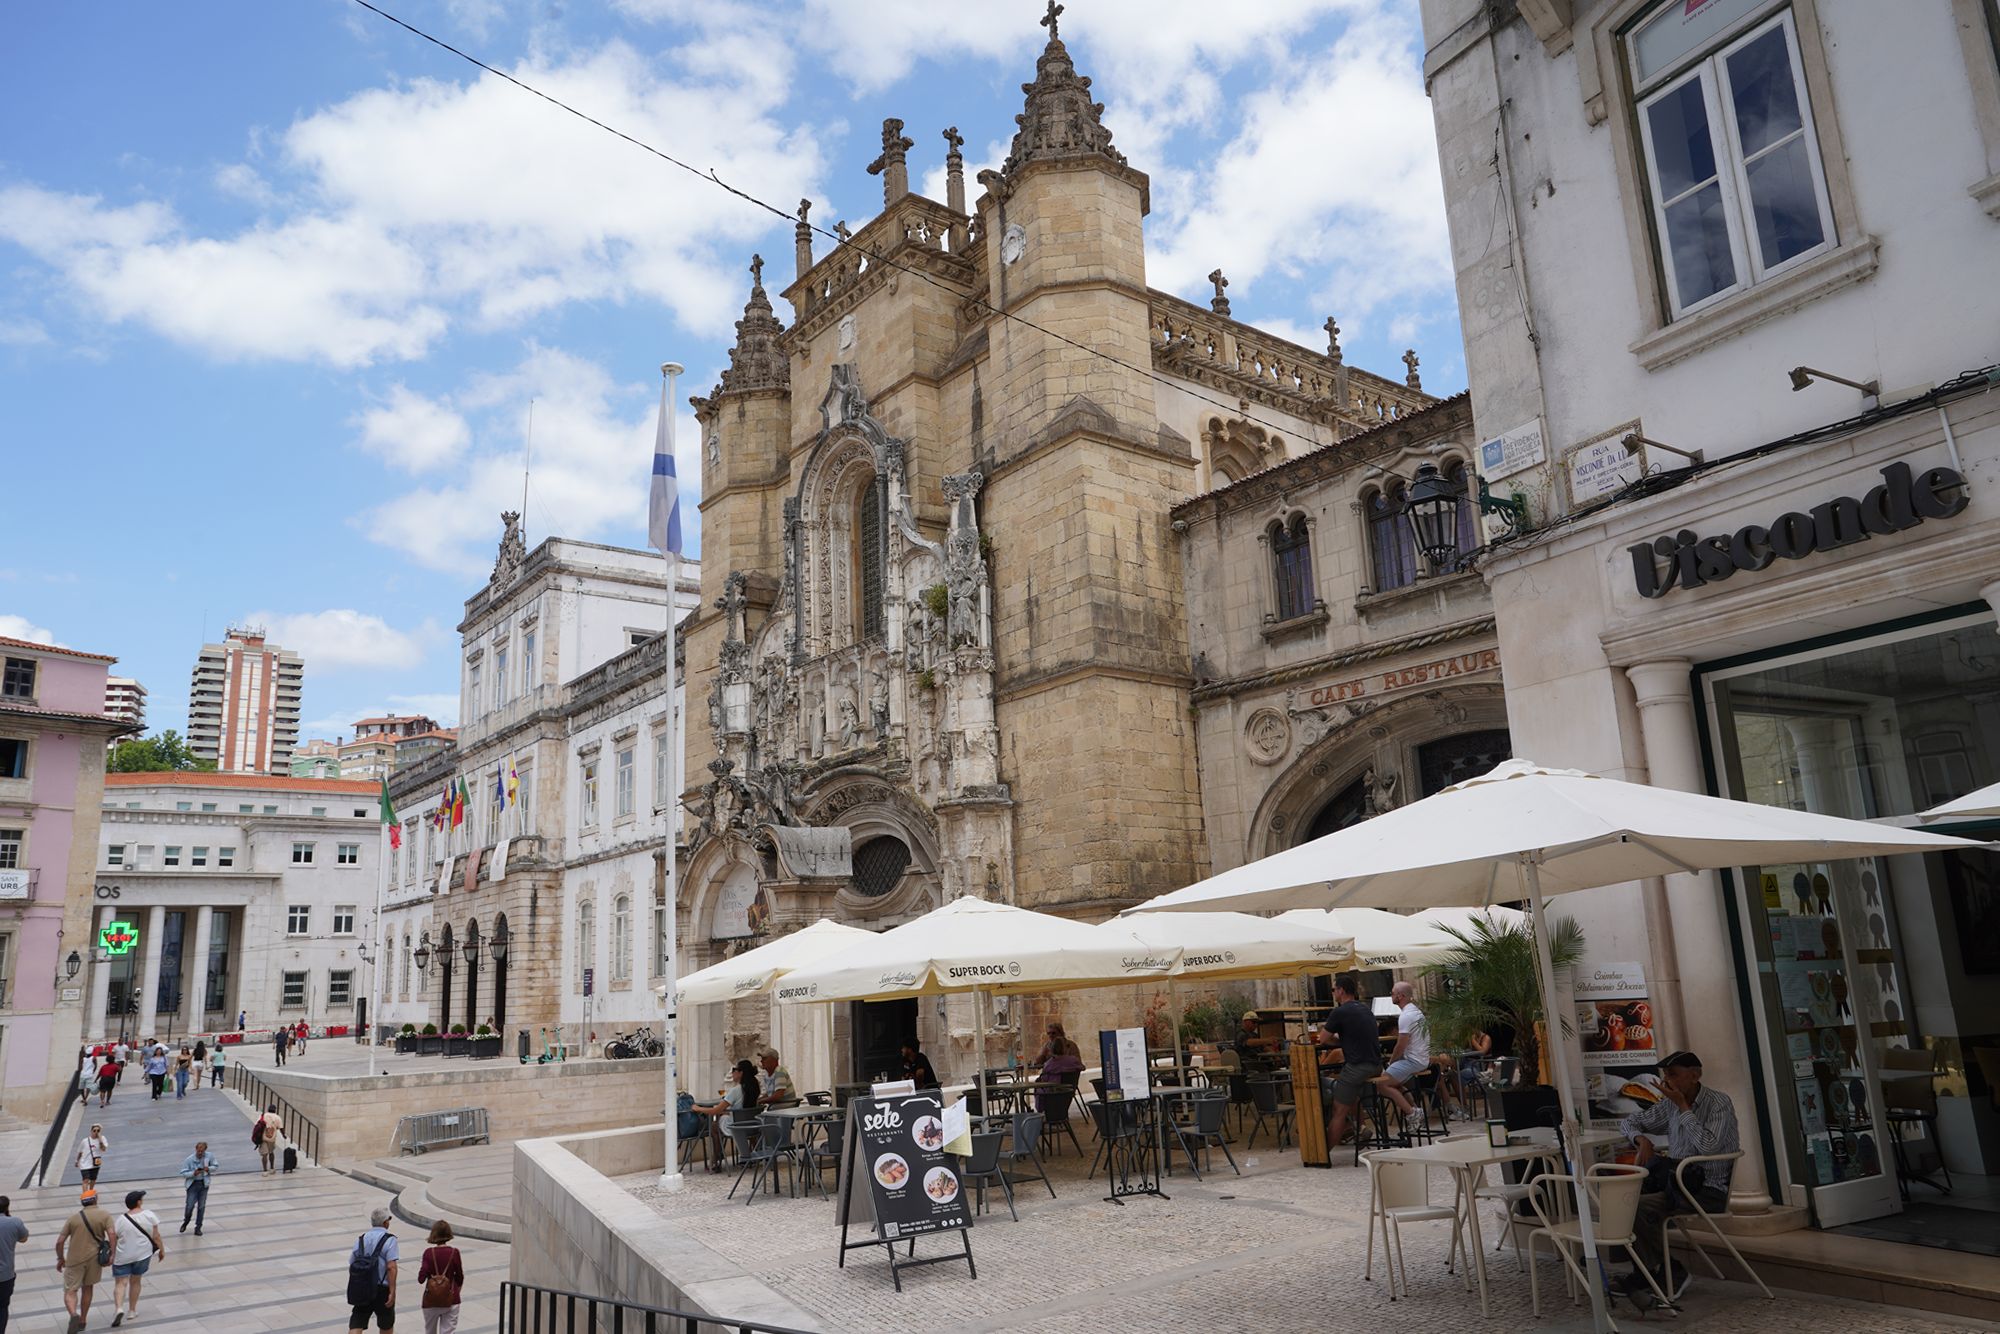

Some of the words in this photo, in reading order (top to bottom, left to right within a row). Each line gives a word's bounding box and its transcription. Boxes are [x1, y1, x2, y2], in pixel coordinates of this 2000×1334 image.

[1592, 445, 1609, 457] RUA
[1576, 457, 1605, 477] VISCONDE
[1627, 461, 1971, 599] Visconde
[1203, 954, 1224, 965] BOCK
[1382, 955, 1399, 965] BOCK
[949, 966, 979, 978] SUPER
[980, 964, 1006, 976] BOCK
[779, 988, 794, 999] SUPER
[794, 986, 809, 997] BOCK
